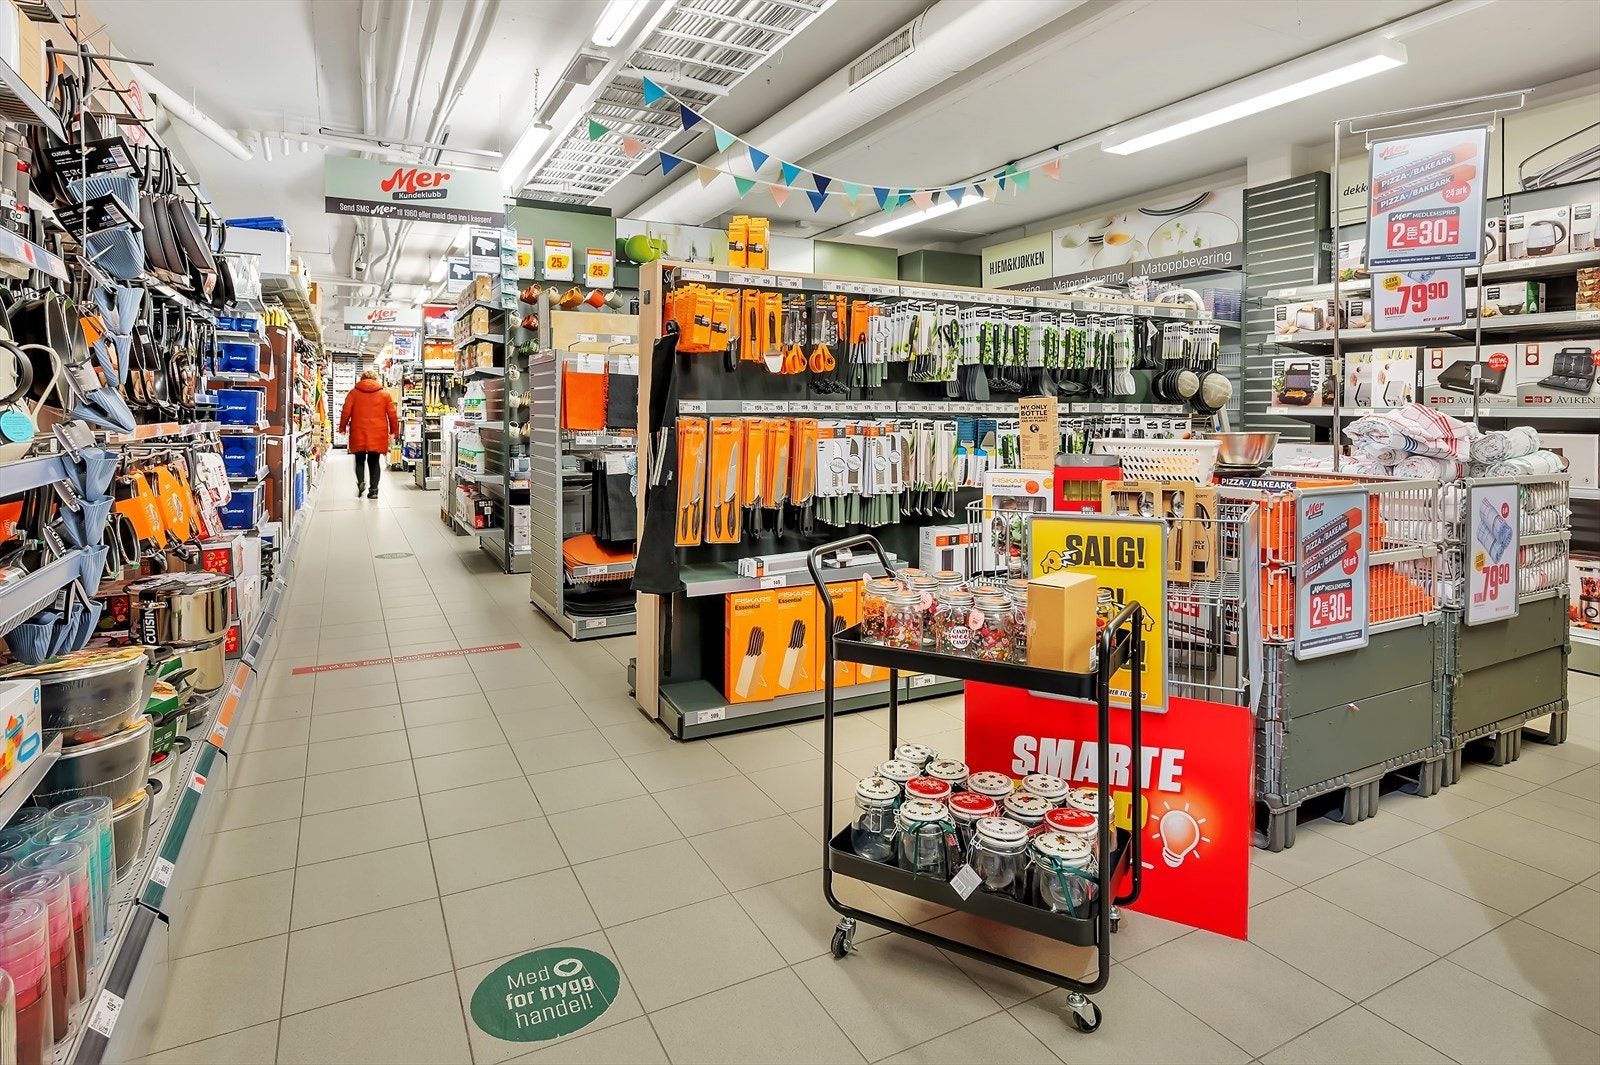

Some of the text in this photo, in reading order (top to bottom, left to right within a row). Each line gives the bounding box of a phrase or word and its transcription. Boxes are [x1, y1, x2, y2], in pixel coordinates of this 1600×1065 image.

[380, 168, 450, 194] Mer
[1382, 155, 1452, 188] PIZZA-/BAKEARK
[398, 190, 442, 198] Kundeklubb
[1344, 183, 1368, 196] dekk
[1380, 176, 1452, 208] PIZZA-/BAKEARK
[1446, 186, 1468, 198] 24 ark
[340, 203, 356, 212] Send
[356, 204, 370, 213] SMS
[370, 205, 396, 214] Mer
[446, 212, 458, 221] deg
[1392, 209, 1456, 221] Mer MEDLEMSPRIS
[1392, 219, 1458, 246] 2 FOR 30.-
[989, 250, 1045, 275] HJEM&KJØKKEN
[1142, 250, 1232, 276] Matoppbevaring
[368, 309, 398, 320] Mer
[1384, 306, 1400, 316] KUN
[1458, 396, 1490, 404] ÅVIEN
[1556, 396, 1596, 404] ÅVIKEN
[1221, 478, 1294, 489] PIZZA-/BAKEARK
[1306, 502, 1324, 517] Mer
[1305, 520, 1348, 553] PIZZA-/BAKEARK
[1065, 534, 1145, 569] SALG!
[1305, 546, 1348, 578] PIZZA-/BAKEARK
[778, 590, 812, 598] FISKARS
[1312, 584, 1325, 594] Mer
[1312, 596, 1322, 625] 2
[1329, 592, 1352, 622] 30.-
[1012, 735, 1185, 792] SMARTE
[507, 966, 550, 990] Med
[506, 976, 594, 1010] for trygg
[514, 993, 594, 1029] handel!
